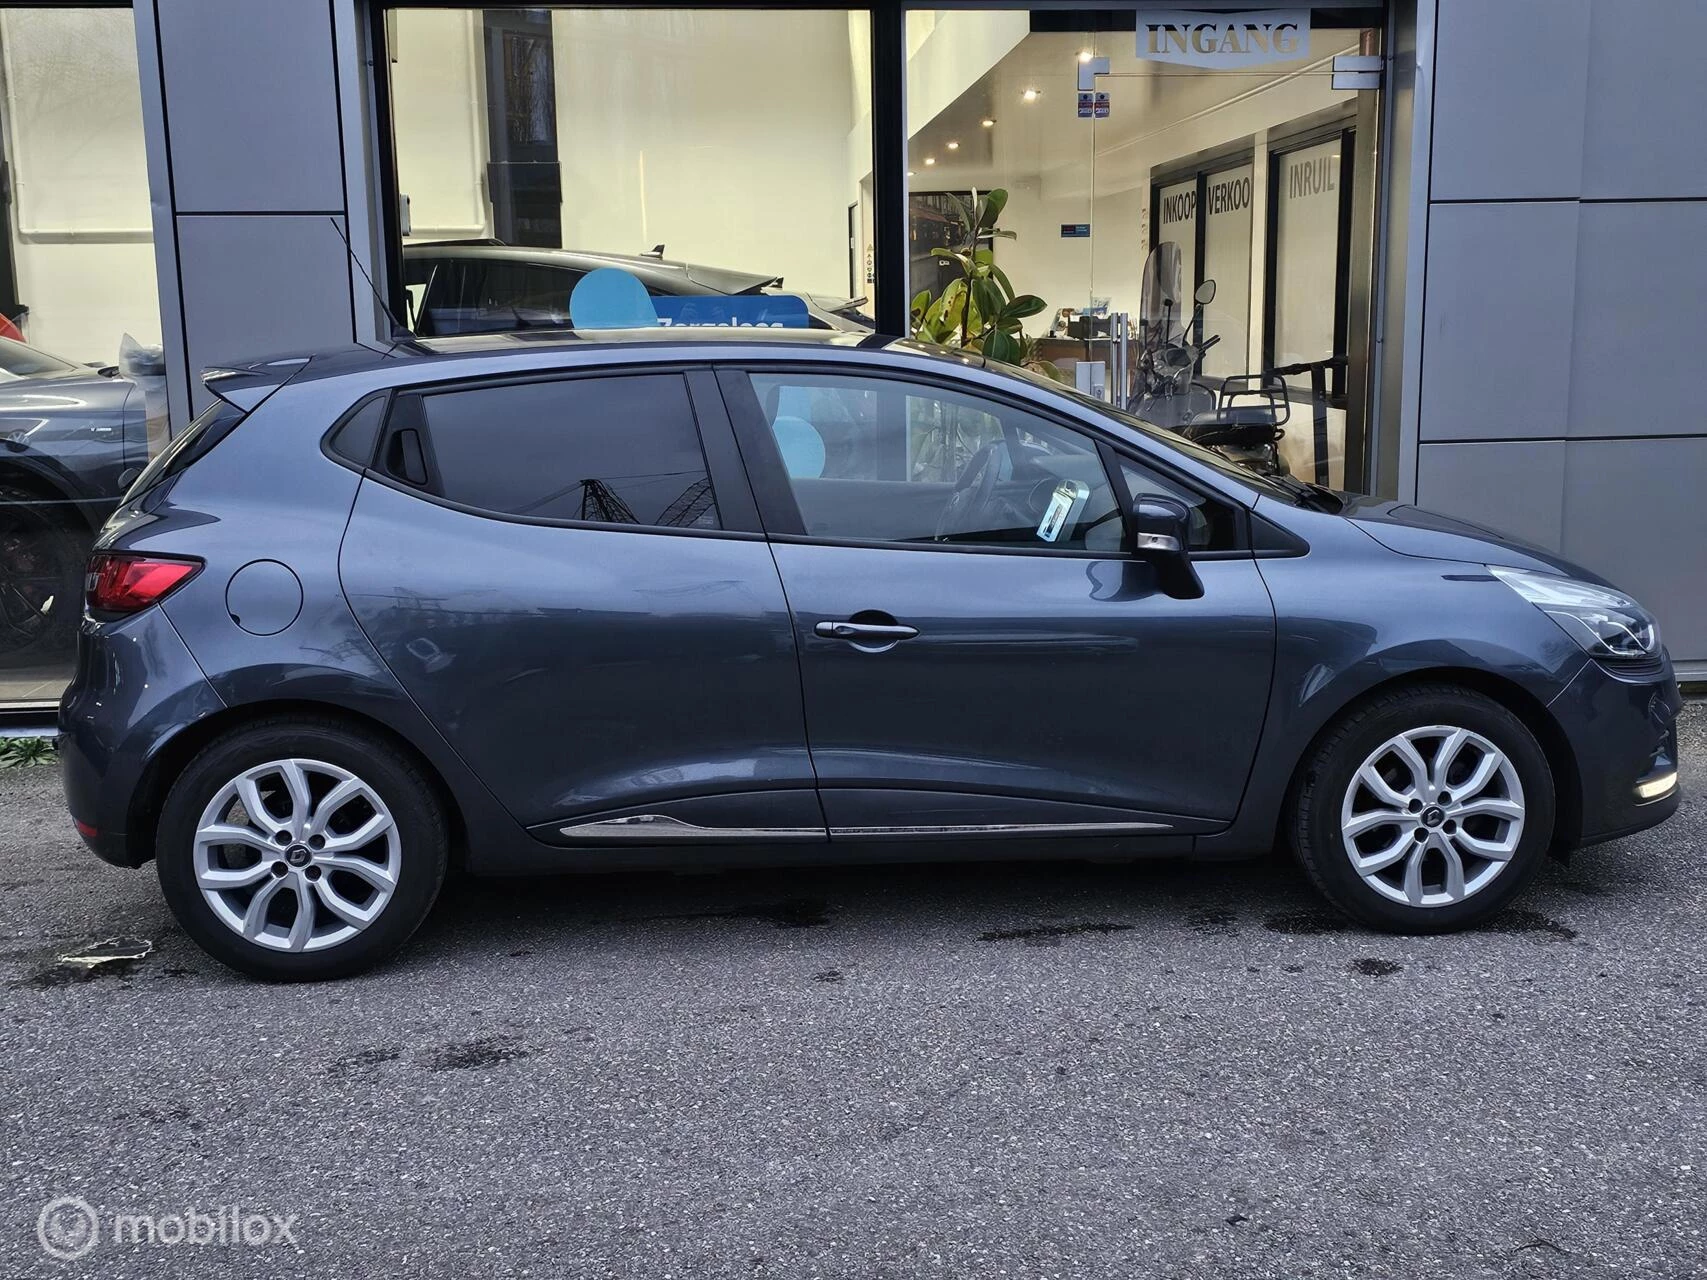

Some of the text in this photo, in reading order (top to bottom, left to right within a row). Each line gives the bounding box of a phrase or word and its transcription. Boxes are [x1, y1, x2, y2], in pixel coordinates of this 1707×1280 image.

[1145, 23, 1299, 54] INGANG
[1290, 156, 1335, 199] INRUIL
[1163, 190, 1197, 225] INKOOP
[1208, 177, 1251, 215] VERKOO
